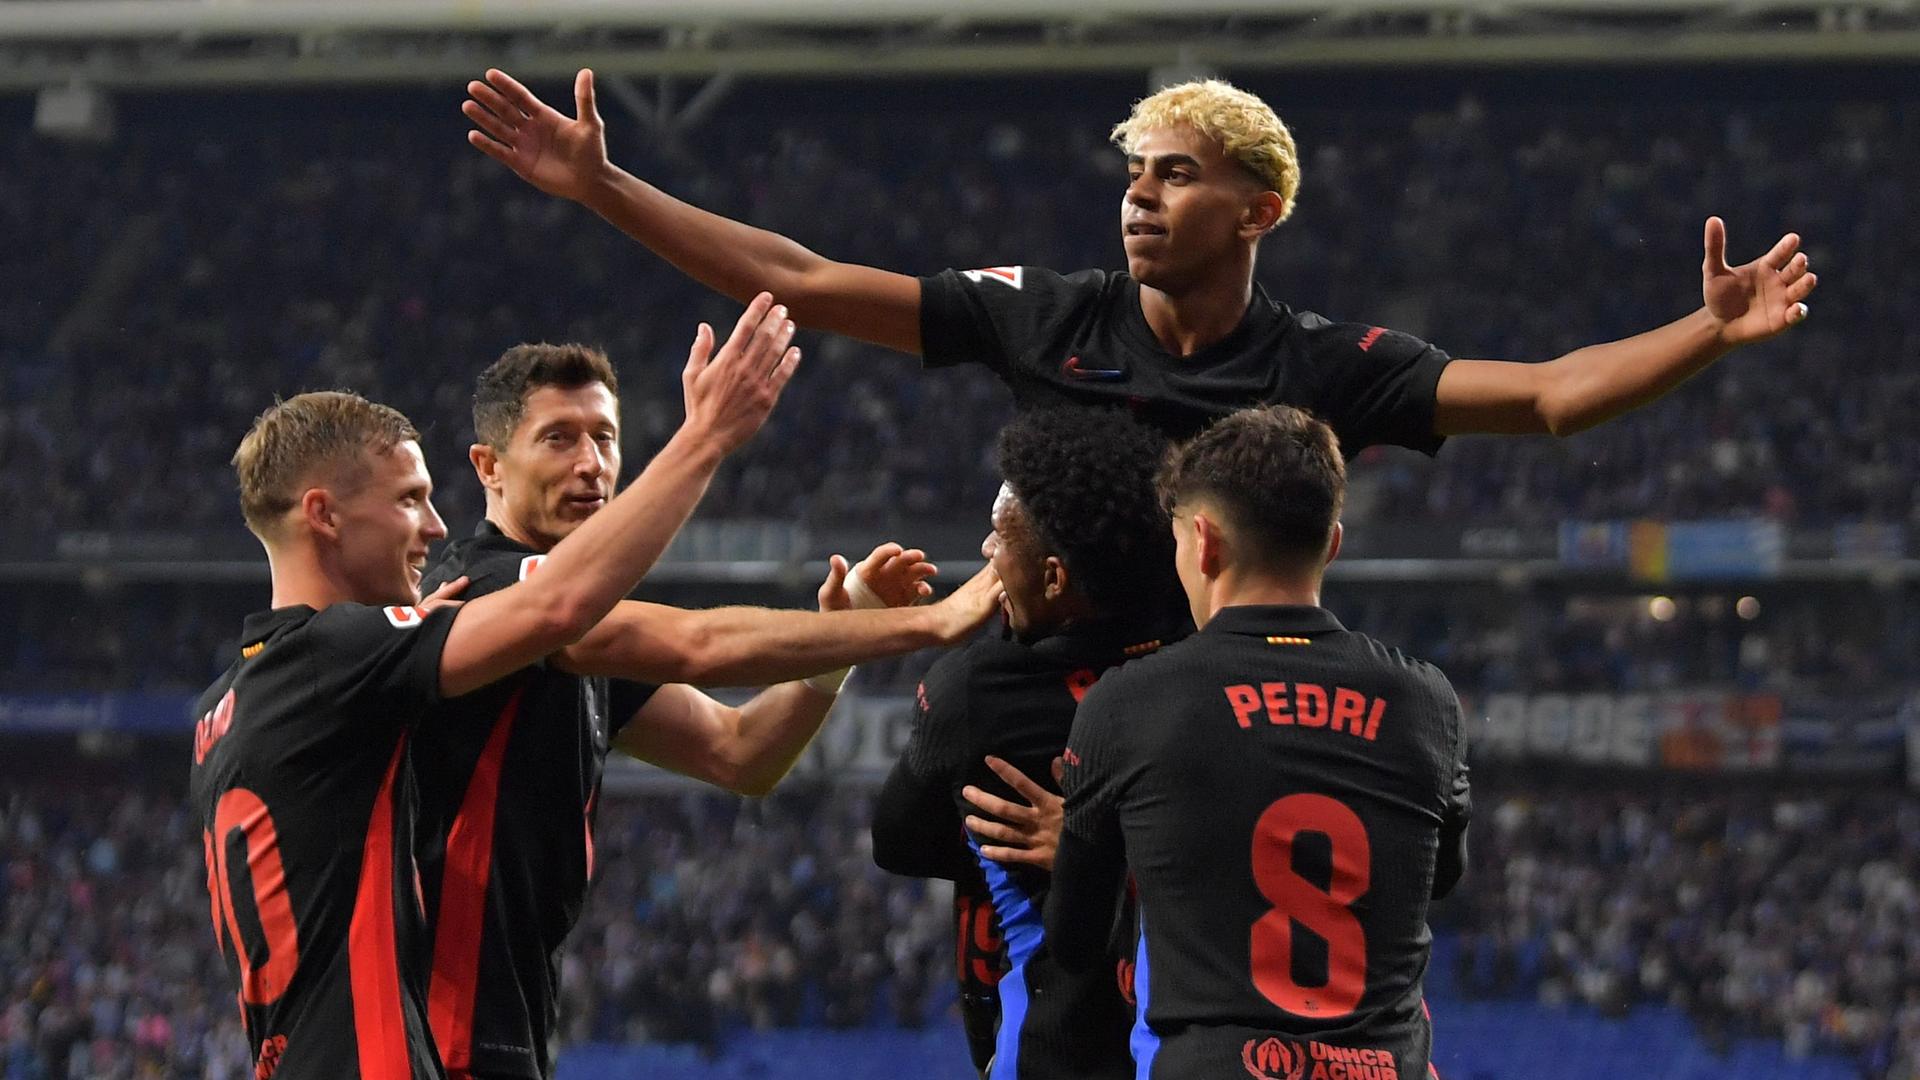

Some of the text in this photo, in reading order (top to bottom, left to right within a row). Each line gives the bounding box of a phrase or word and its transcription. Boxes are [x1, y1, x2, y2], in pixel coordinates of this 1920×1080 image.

[1224, 682, 1387, 741] PEDRI
[1250, 793, 1371, 1019] 8
[1309, 1040, 1396, 1068] UNHCR
[1311, 1060, 1398, 1080] ACNUR
